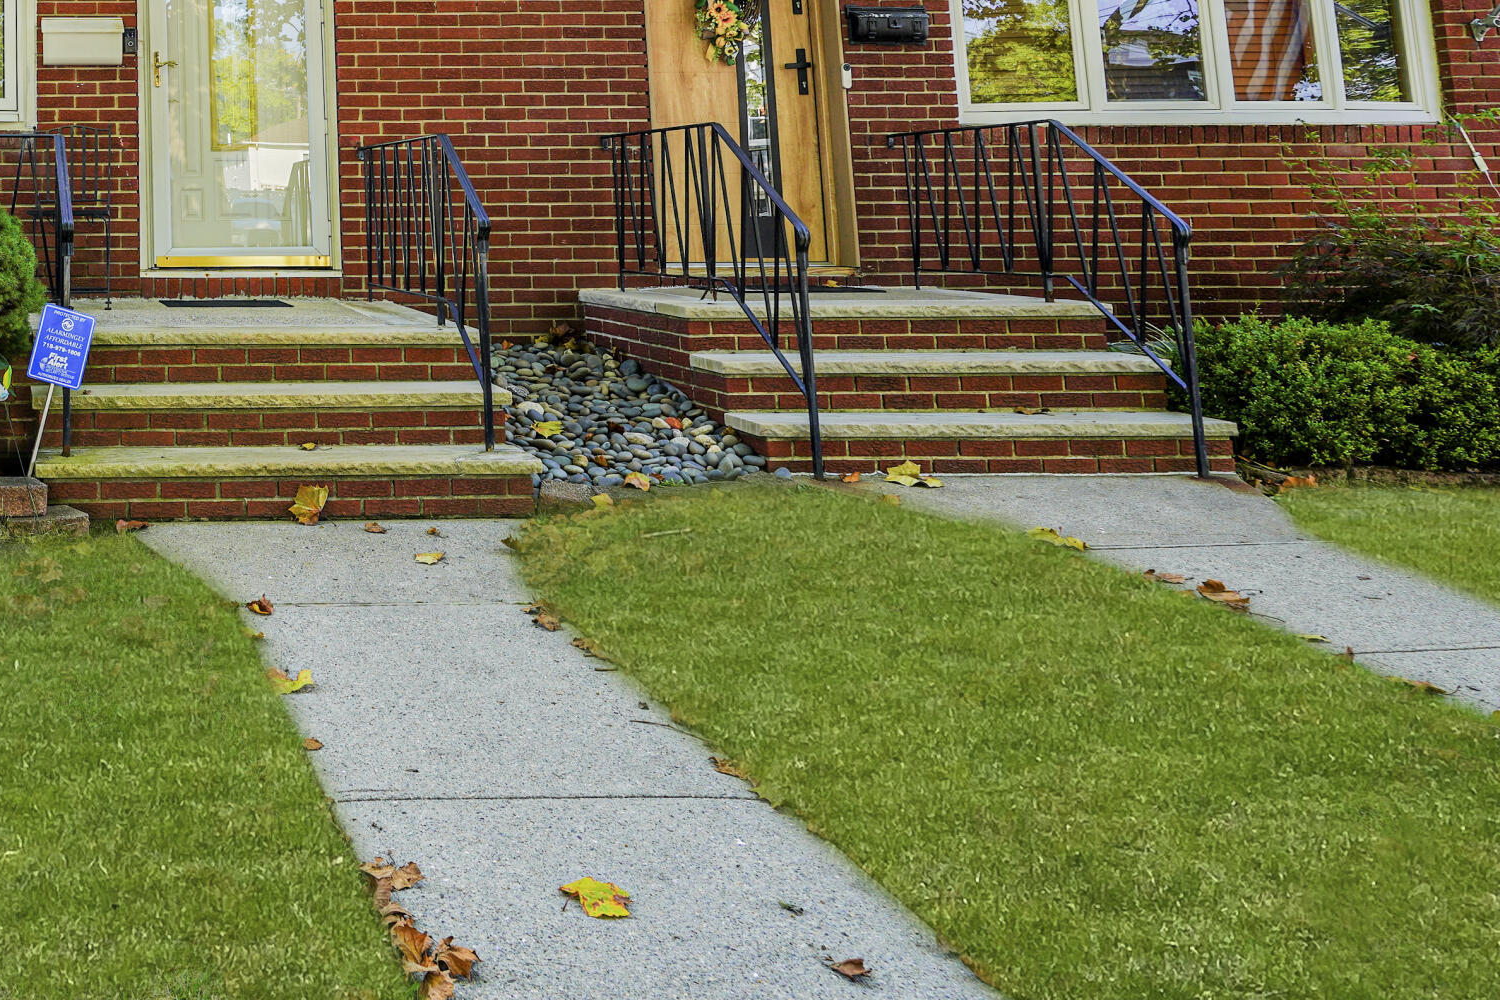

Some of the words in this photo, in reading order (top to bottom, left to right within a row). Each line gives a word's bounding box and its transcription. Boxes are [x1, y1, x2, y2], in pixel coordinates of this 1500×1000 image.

[54, 310, 79, 321] PROTECTED
[46, 328, 85, 342] ALARMINGLY
[44, 335, 84, 350] AFFORDABLE
[47, 359, 68, 369] Alert
[48, 352, 68, 364] First
